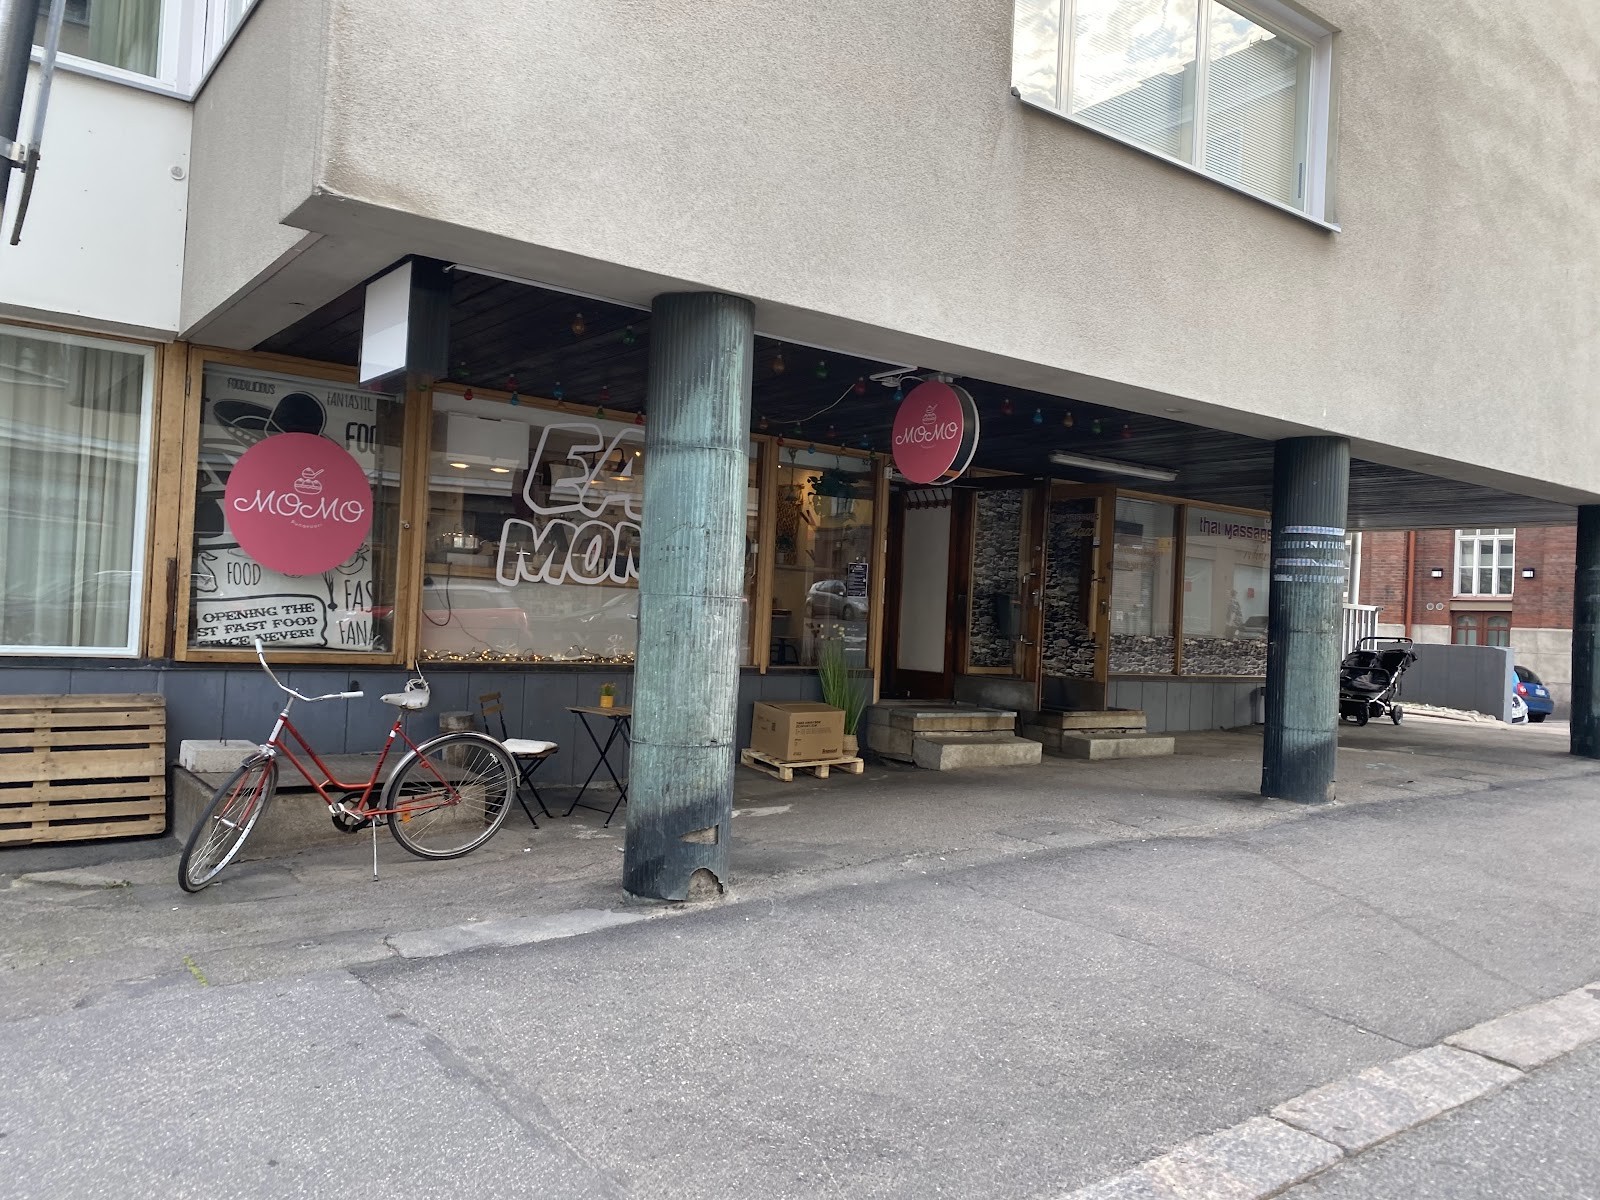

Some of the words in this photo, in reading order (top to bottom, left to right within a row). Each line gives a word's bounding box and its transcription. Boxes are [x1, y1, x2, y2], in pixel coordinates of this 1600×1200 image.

[327, 391, 374, 412] FANTASTIC
[895, 421, 959, 445] MOMO
[233, 489, 365, 523] MOMO
[227, 562, 262, 586] FOOD
[202, 606, 279, 624] OPENING
[281, 602, 316, 615] THE
[224, 620, 267, 635] FAST
[272, 616, 318, 629] FOOD
